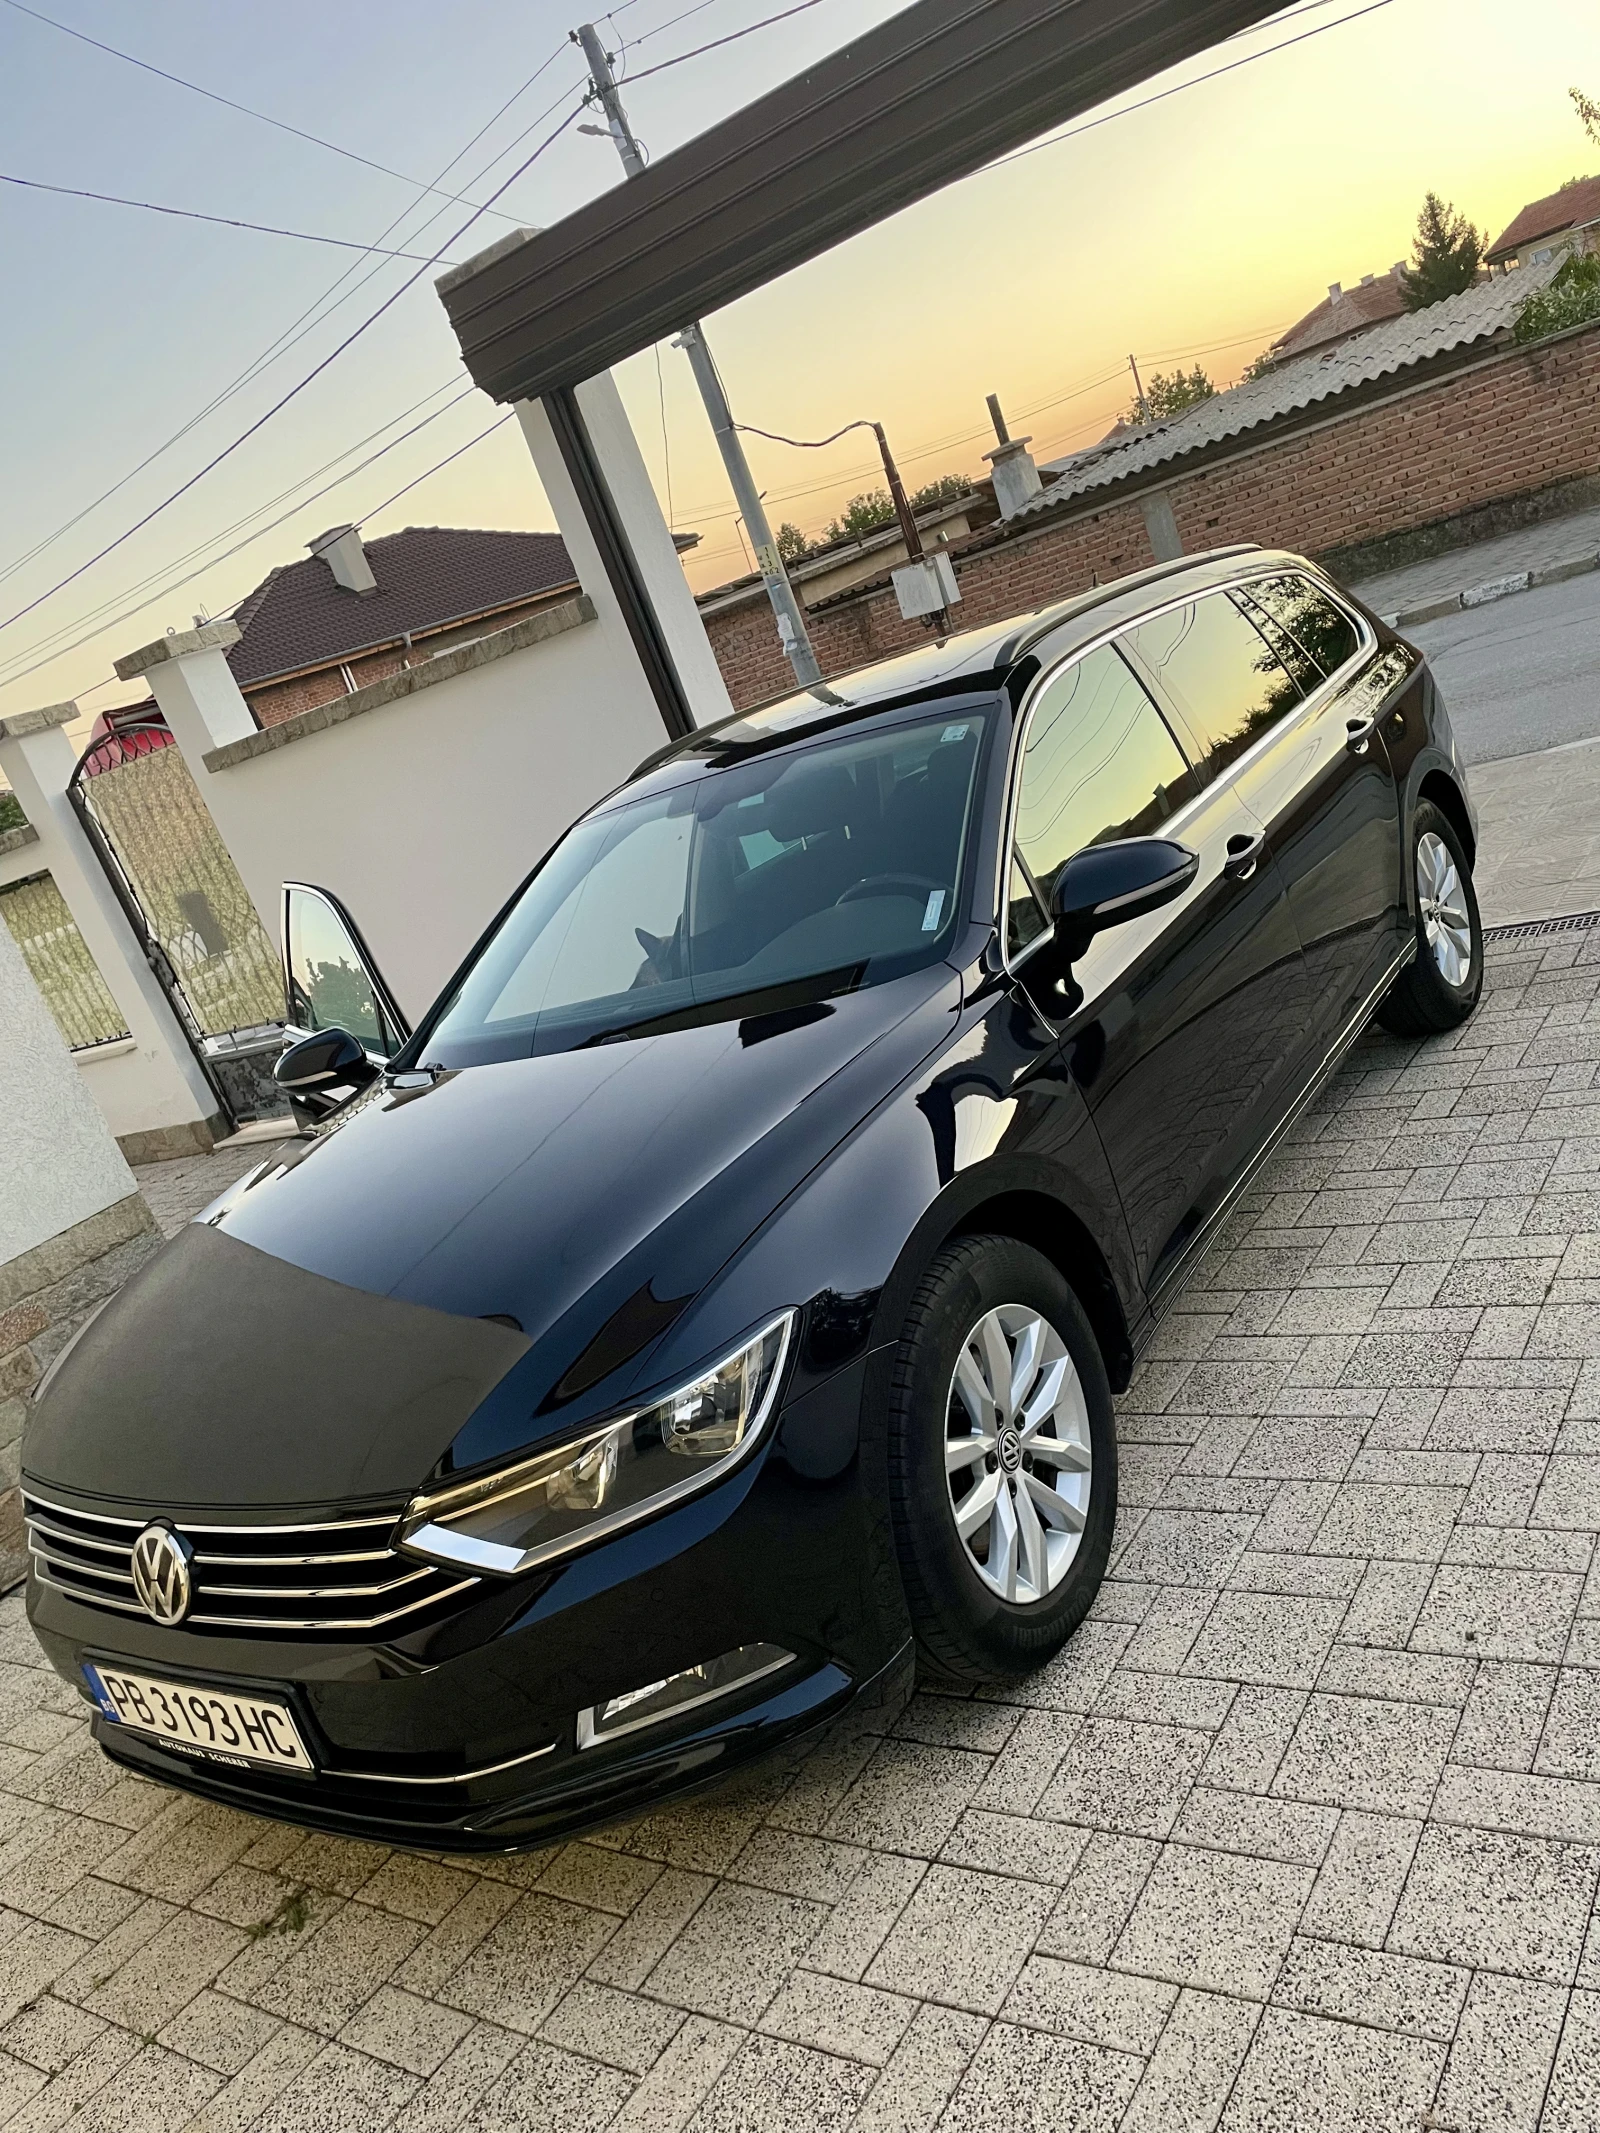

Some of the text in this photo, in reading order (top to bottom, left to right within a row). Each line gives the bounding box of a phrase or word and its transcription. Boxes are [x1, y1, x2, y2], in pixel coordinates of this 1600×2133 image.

[132, 1530, 187, 1622] VW
[100, 1699, 115, 1714] BG
[158, 1738, 252, 1769] AUTOHAUS SCHERER
